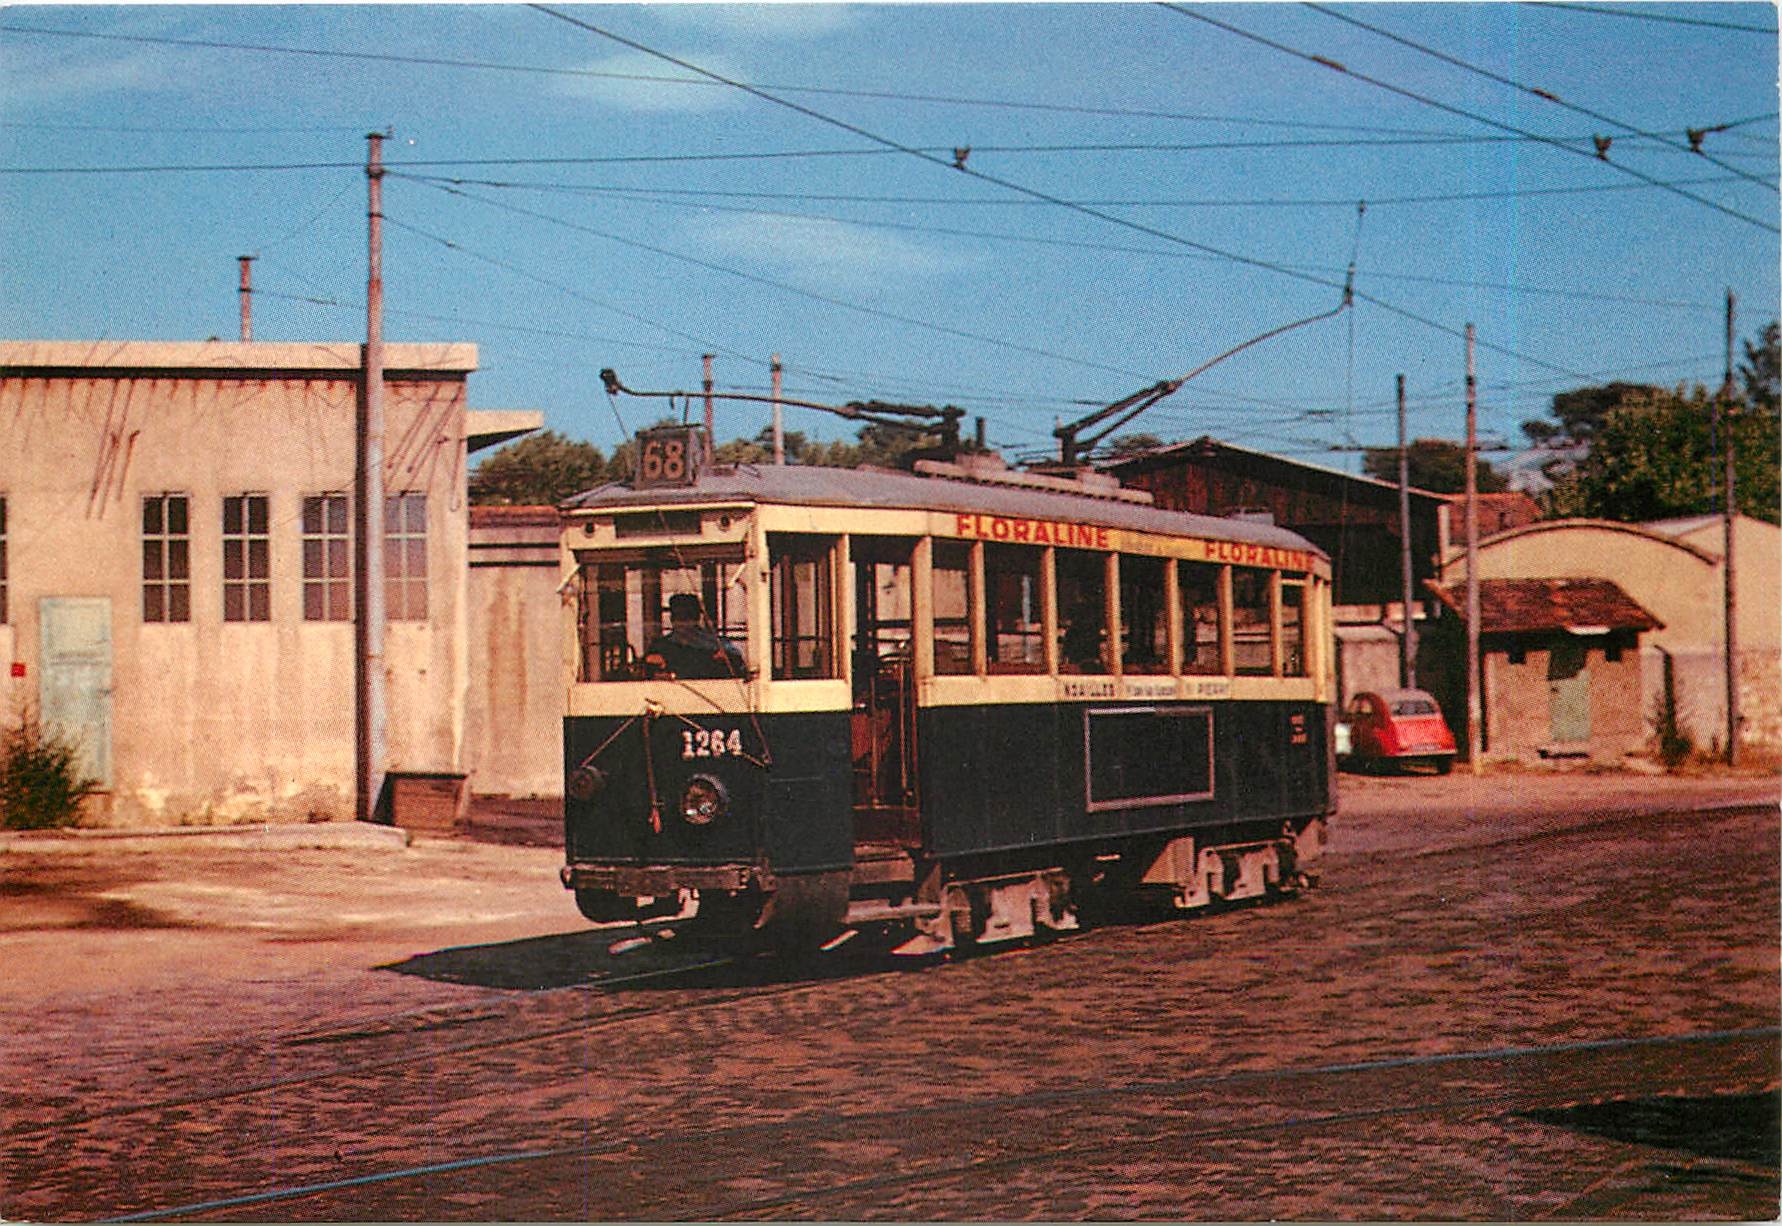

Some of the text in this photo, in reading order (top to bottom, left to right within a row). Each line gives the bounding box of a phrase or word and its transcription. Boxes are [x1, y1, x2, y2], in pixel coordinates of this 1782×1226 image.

[643, 440, 685, 480] 68
[957, 513, 1109, 548] FLORALINE
[1203, 539, 1315, 572] FLORALINE
[681, 729, 743, 760] 1264
